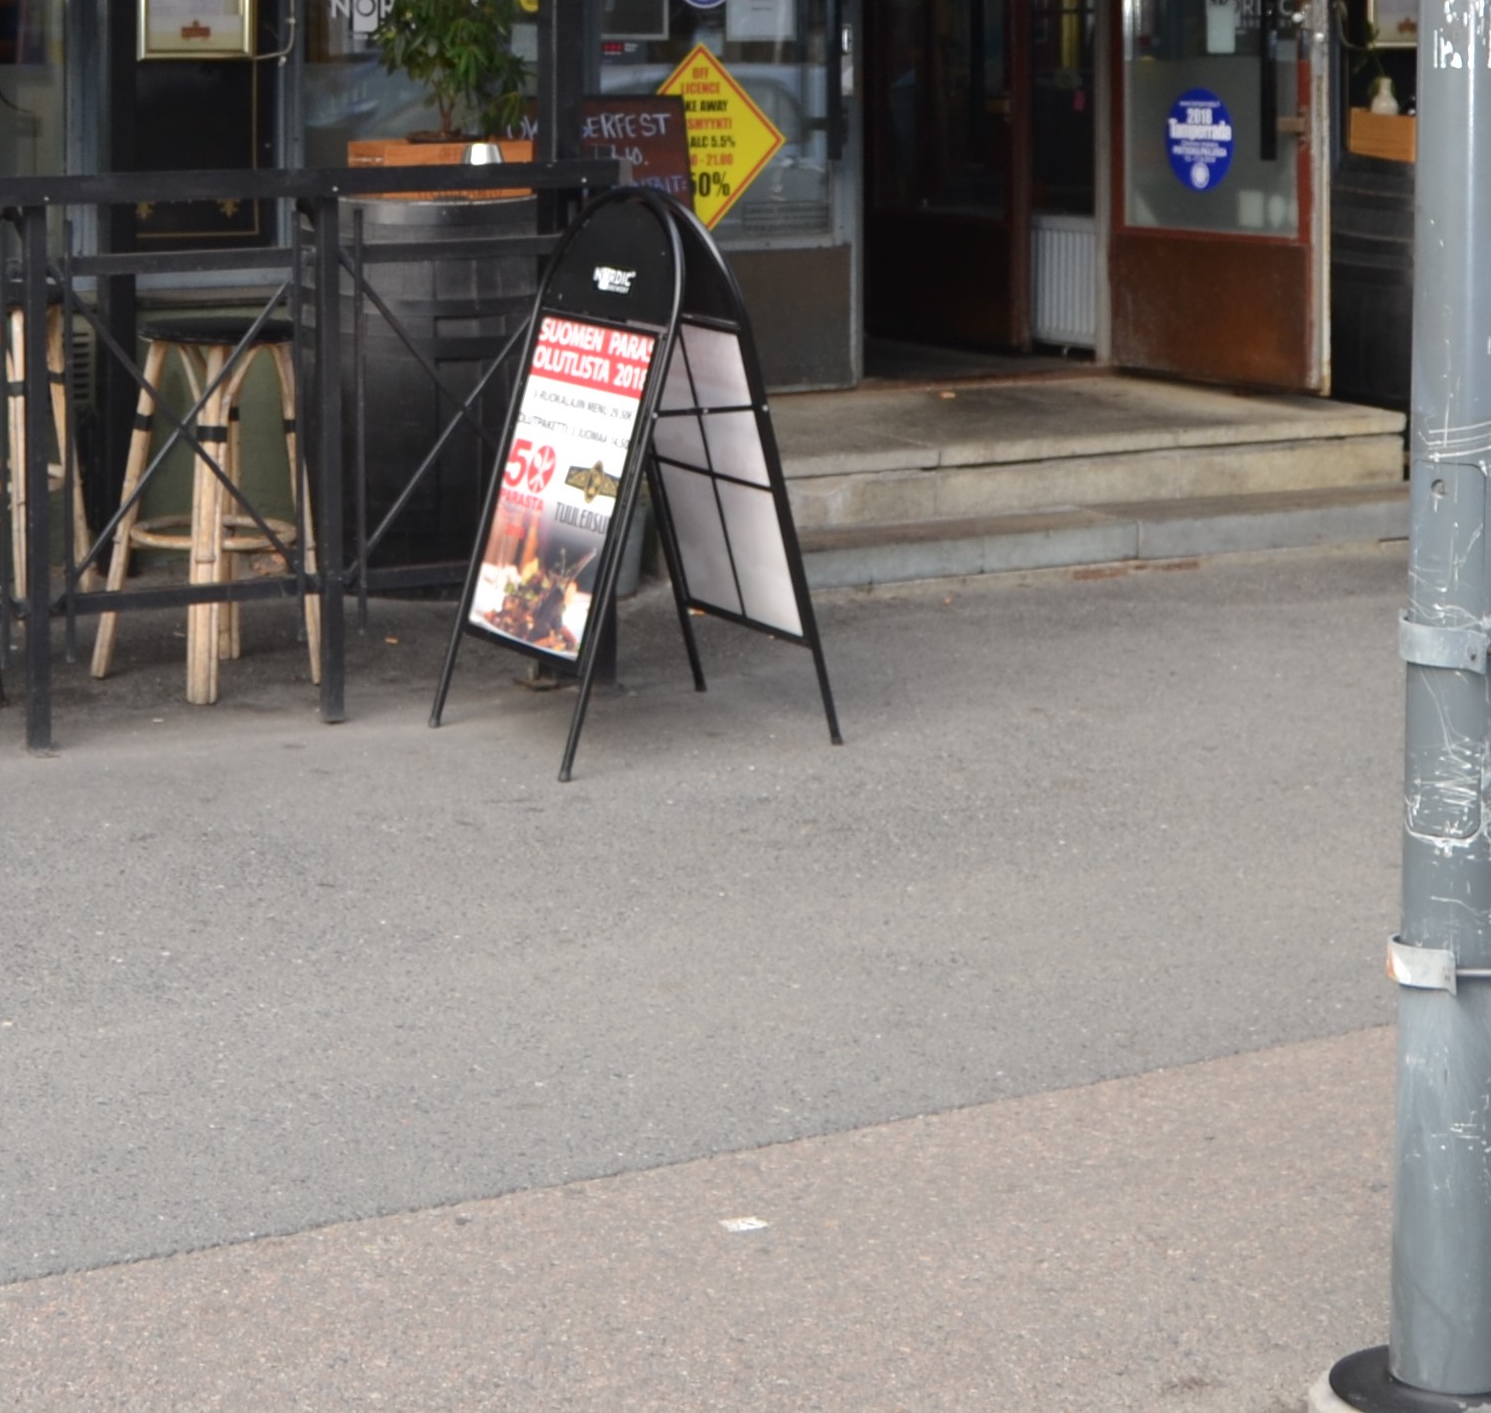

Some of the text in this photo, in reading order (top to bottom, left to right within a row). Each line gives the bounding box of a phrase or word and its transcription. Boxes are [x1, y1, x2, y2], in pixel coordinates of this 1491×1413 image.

[692, 67, 710, 79] OFF
[681, 82, 721, 94] LICENCE
[700, 100, 728, 112] AWAY
[688, 118, 733, 130] SMYYNTI
[538, 316, 605, 353] SUOMEN
[532, 344, 611, 384] OLUTLISTA
[503, 437, 557, 494] 50
[500, 487, 544, 512] PARASTA
[554, 501, 610, 535] TUULENSU
